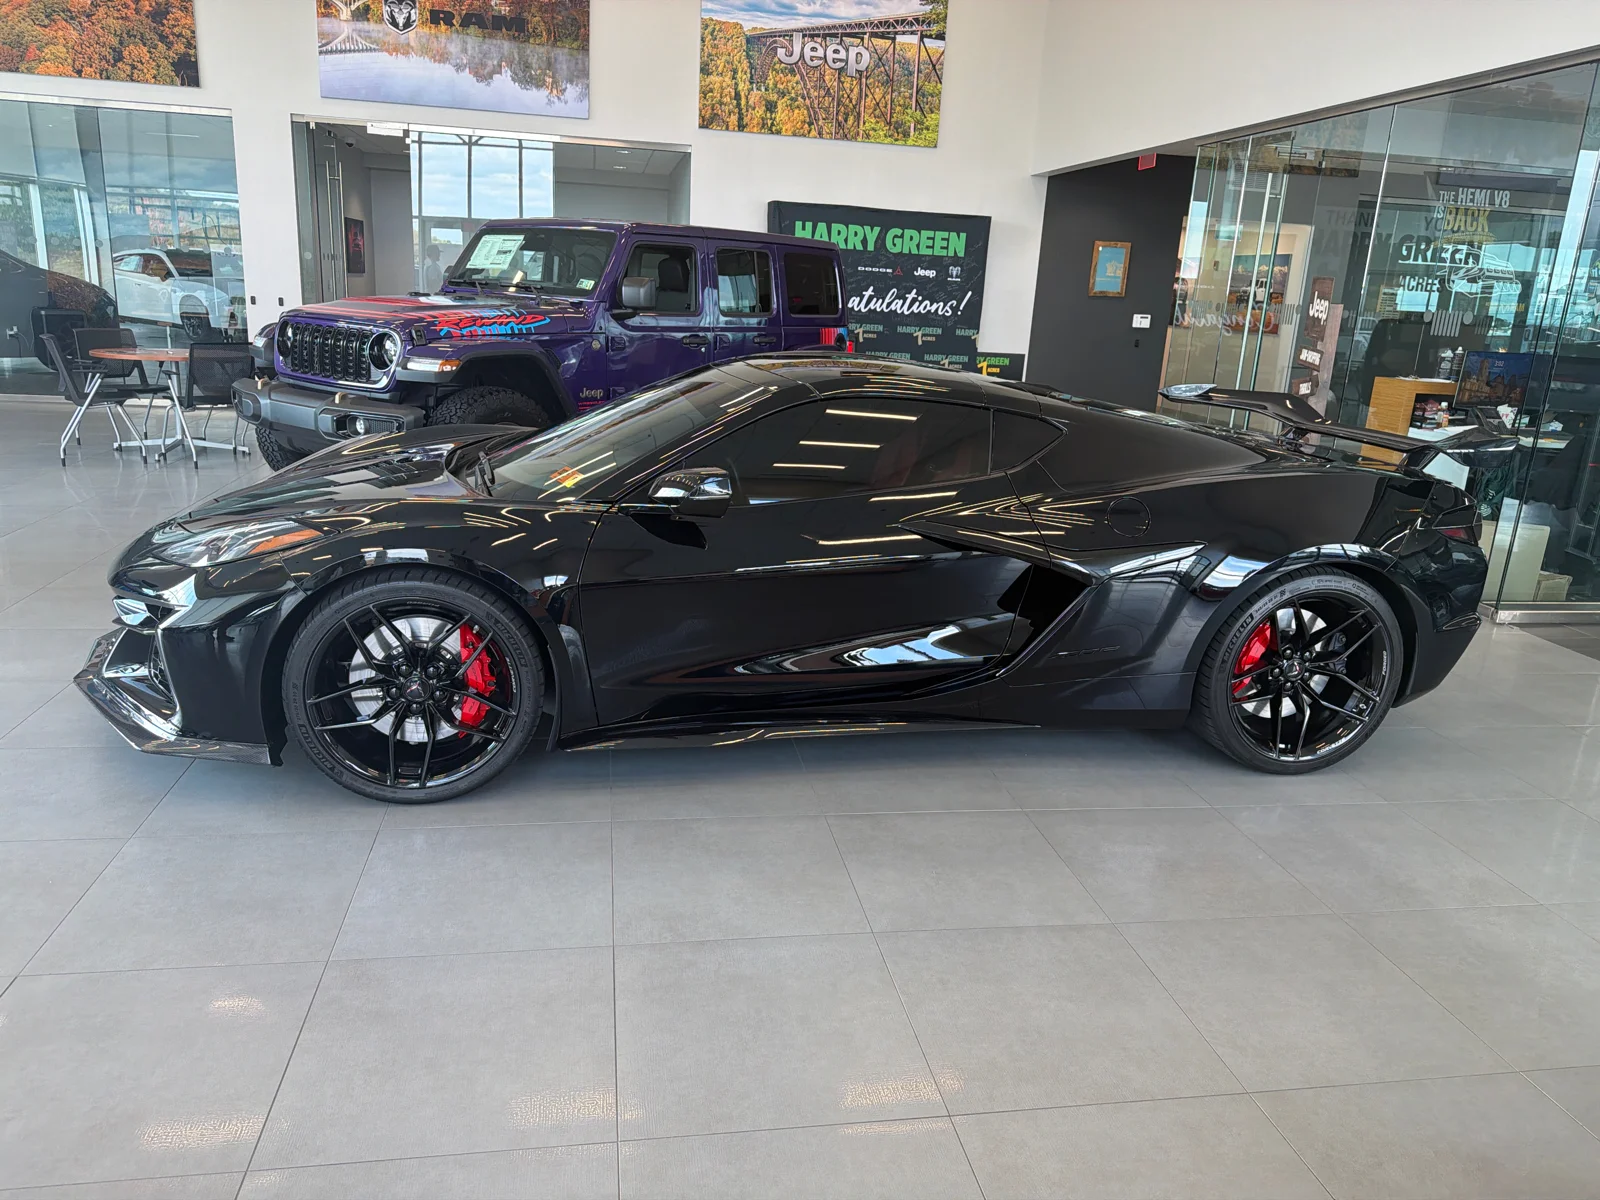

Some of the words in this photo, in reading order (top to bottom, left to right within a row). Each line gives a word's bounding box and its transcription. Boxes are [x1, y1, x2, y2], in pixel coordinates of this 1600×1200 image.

[429, 9, 526, 34] RAM
[777, 31, 871, 78] Jeep
[1439, 190, 1456, 204] THE
[1457, 187, 1491, 207] HEMI
[1494, 189, 1511, 209] V8
[1444, 205, 1491, 232] BACK
[794, 220, 881, 251] HARRY
[885, 227, 967, 258] GREEN
[913, 266, 937, 279] Jeep
[1308, 290, 1329, 325] Jeep
[436, 314, 545, 332] REWIND
[861, 324, 883, 332] GREEN
[897, 325, 920, 334] HARRY
[920, 326, 942, 335] GREEN
[955, 328, 978, 337] HARRY
[924, 353, 947, 361] HARRY
[947, 355, 969, 363] GREEN
[985, 357, 1010, 365] GREEN
[579, 387, 604, 400] Jeep
[496, 623, 528, 667] MICHELIN
[1223, 613, 1254, 661] MICHELIN
[299, 725, 333, 769] MICHELIN
